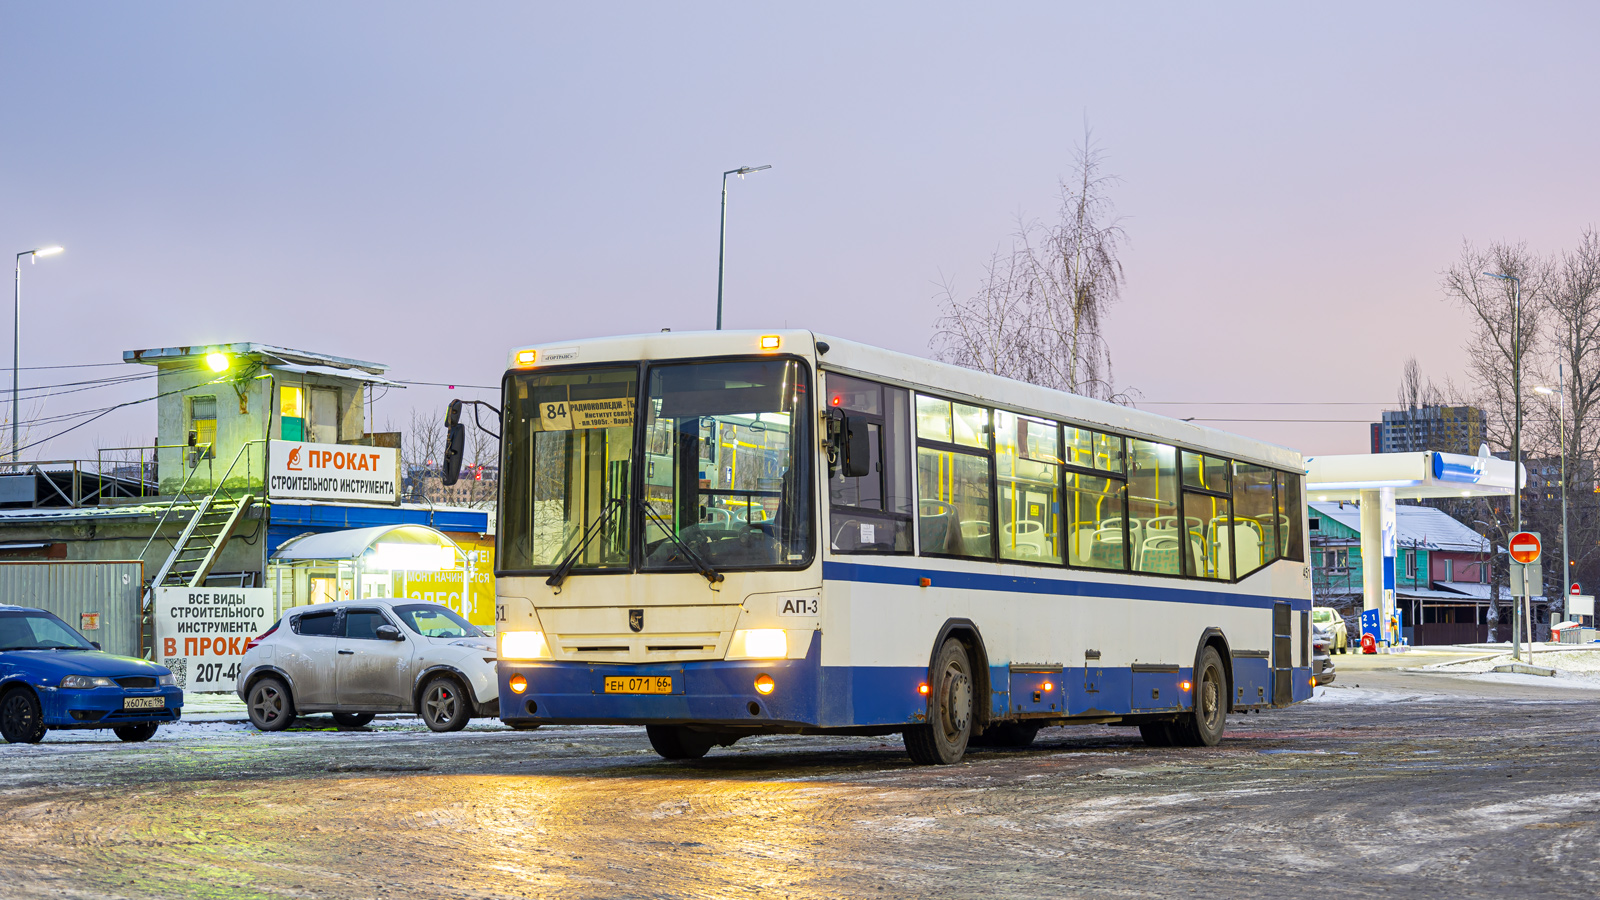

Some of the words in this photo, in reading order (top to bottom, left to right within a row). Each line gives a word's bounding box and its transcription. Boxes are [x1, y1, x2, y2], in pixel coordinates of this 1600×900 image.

[547, 403, 567, 419] 84
[570, 401, 623, 412] РАДИОКОЛЛЕДЖ
[585, 411, 612, 419] Институт
[308, 450, 380, 472] ПРОКАТ
[271, 475, 338, 492] СТРОИТЕЛЬНОГО
[340, 479, 394, 495] ИНСТРУМЕНТА
[396, 571, 432, 582] РМОНТ
[435, 572, 490, 583] НАЧИНЕТСЯ
[188, 594, 210, 605] ВСЕ
[213, 594, 245, 606] ВИДЫ
[170, 607, 265, 618] СТРОИТЕЛЬНОГО
[782, 599, 818, 614] АП-3
[1362, 614, 1368, 622] 2
[1371, 613, 1376, 621] 1
[177, 622, 258, 633] ИНСТРУМЕНТА
[163, 637, 177, 657] В
[184, 637, 257, 656] ПРОКА
[610, 681, 624, 691] ЕН
[629, 678, 650, 691] 071
[656, 677, 668, 688] 66
